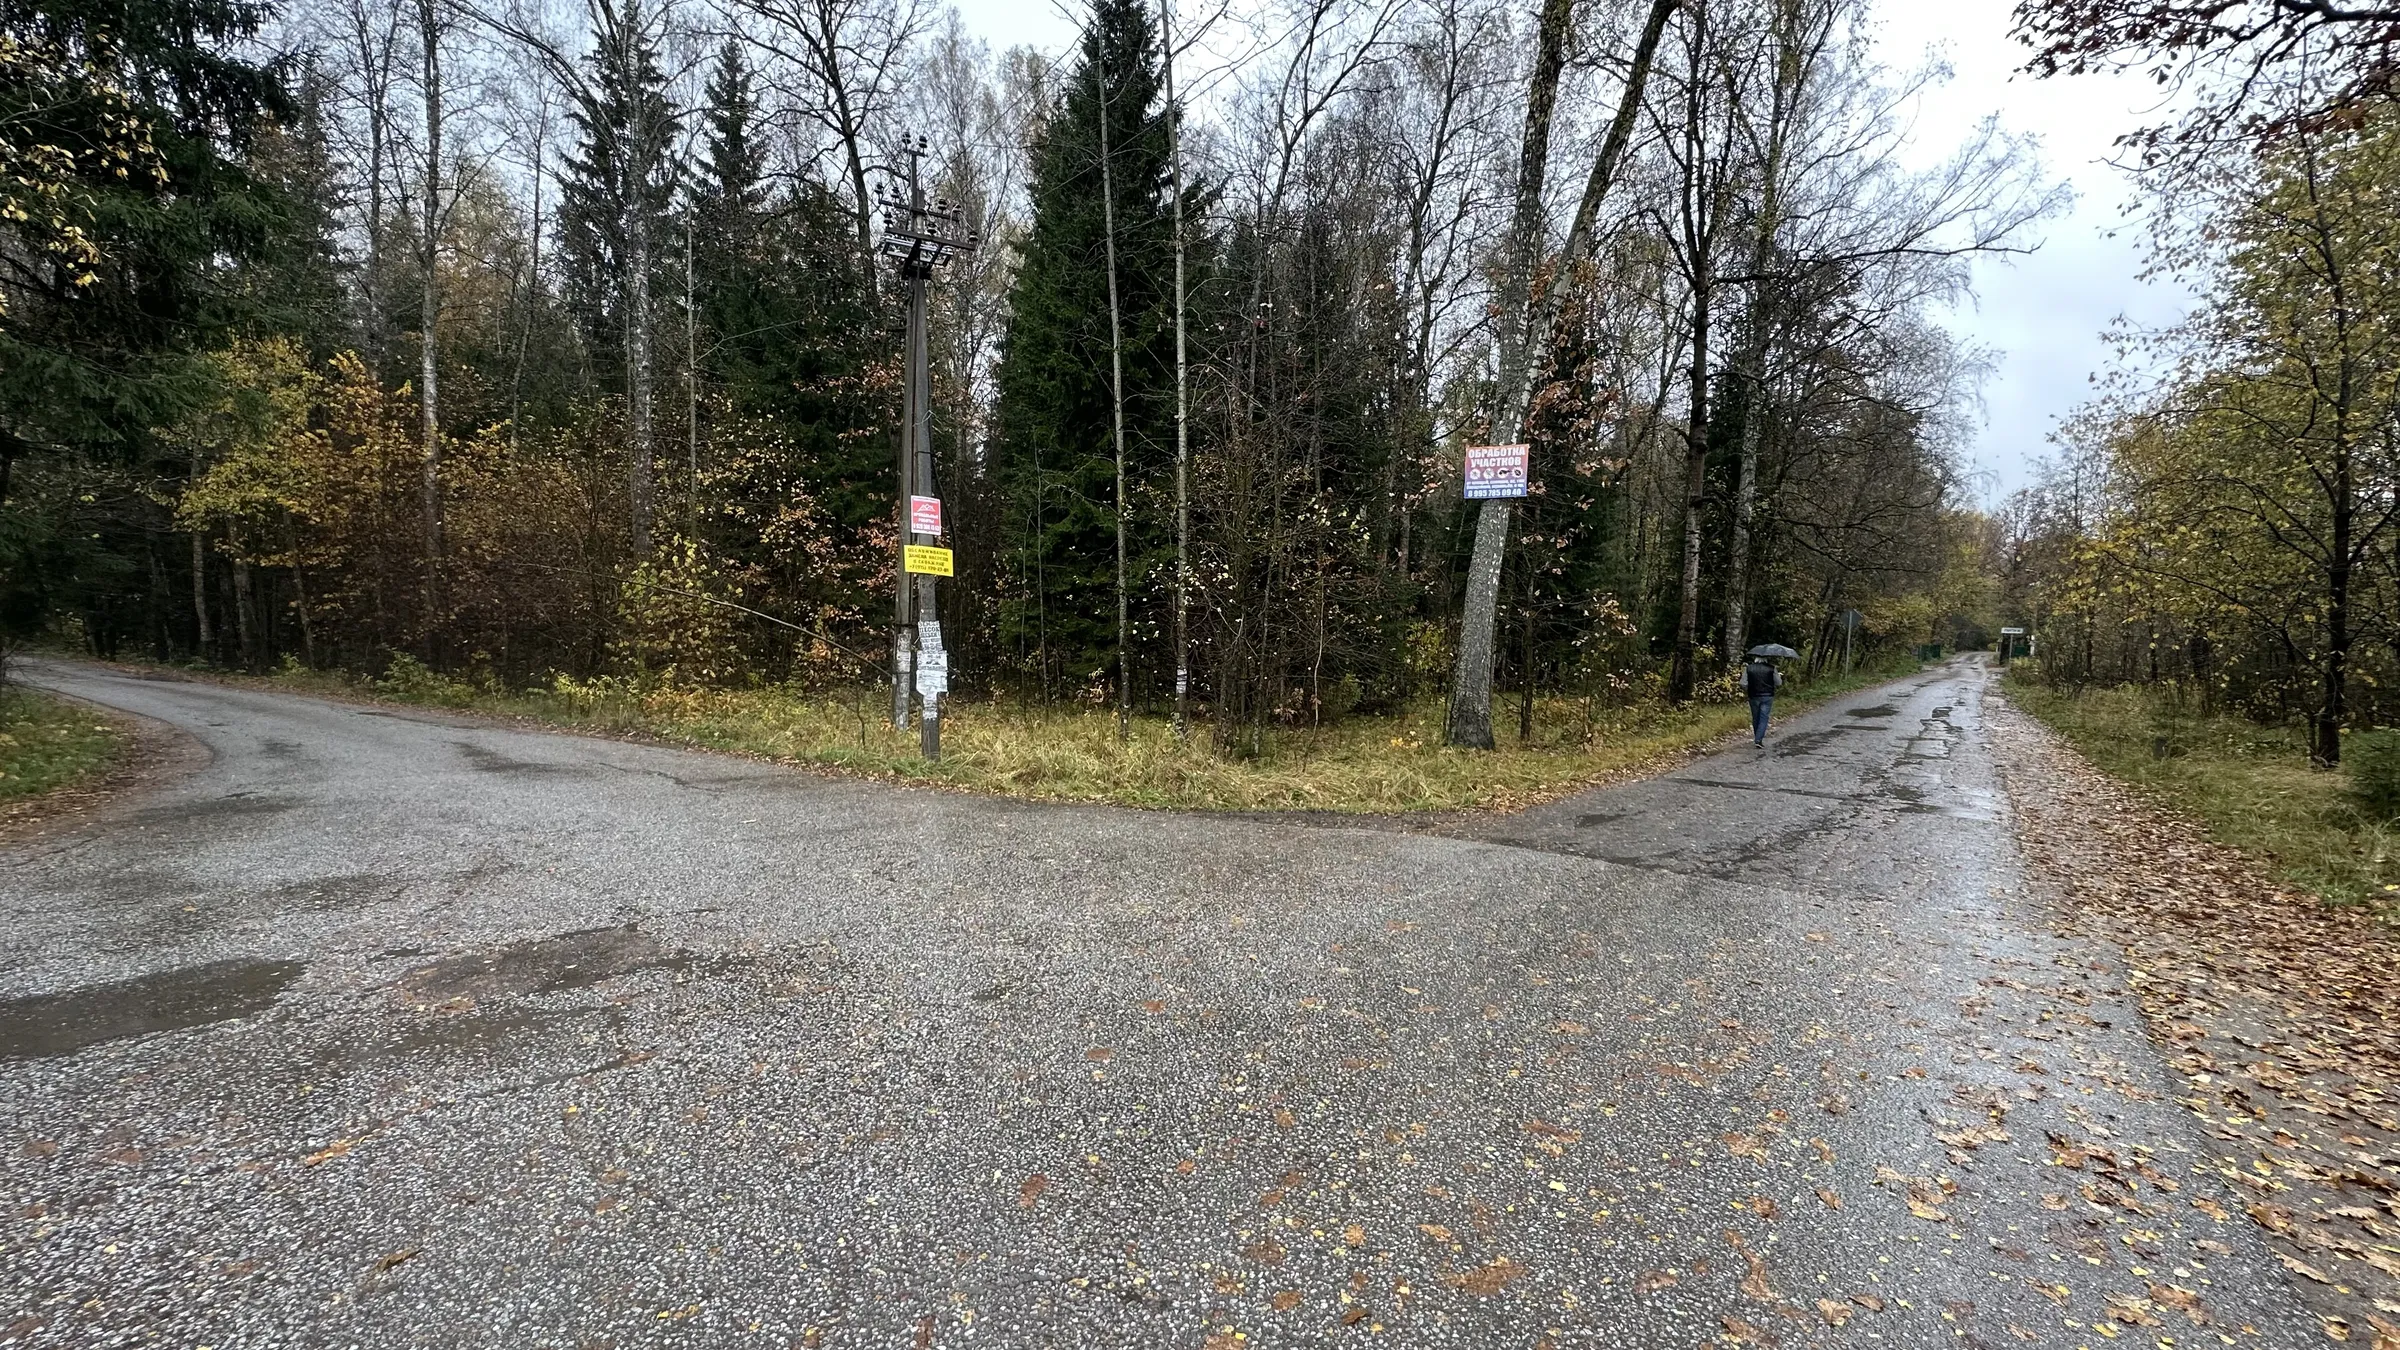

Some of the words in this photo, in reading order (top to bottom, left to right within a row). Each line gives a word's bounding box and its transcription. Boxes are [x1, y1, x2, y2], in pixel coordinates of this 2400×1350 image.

[1468, 447, 1526, 458] ОБРАБОТКА
[1471, 457, 1522, 467] УЧАСТКОВ
[1512, 488, 1522, 496] 40
